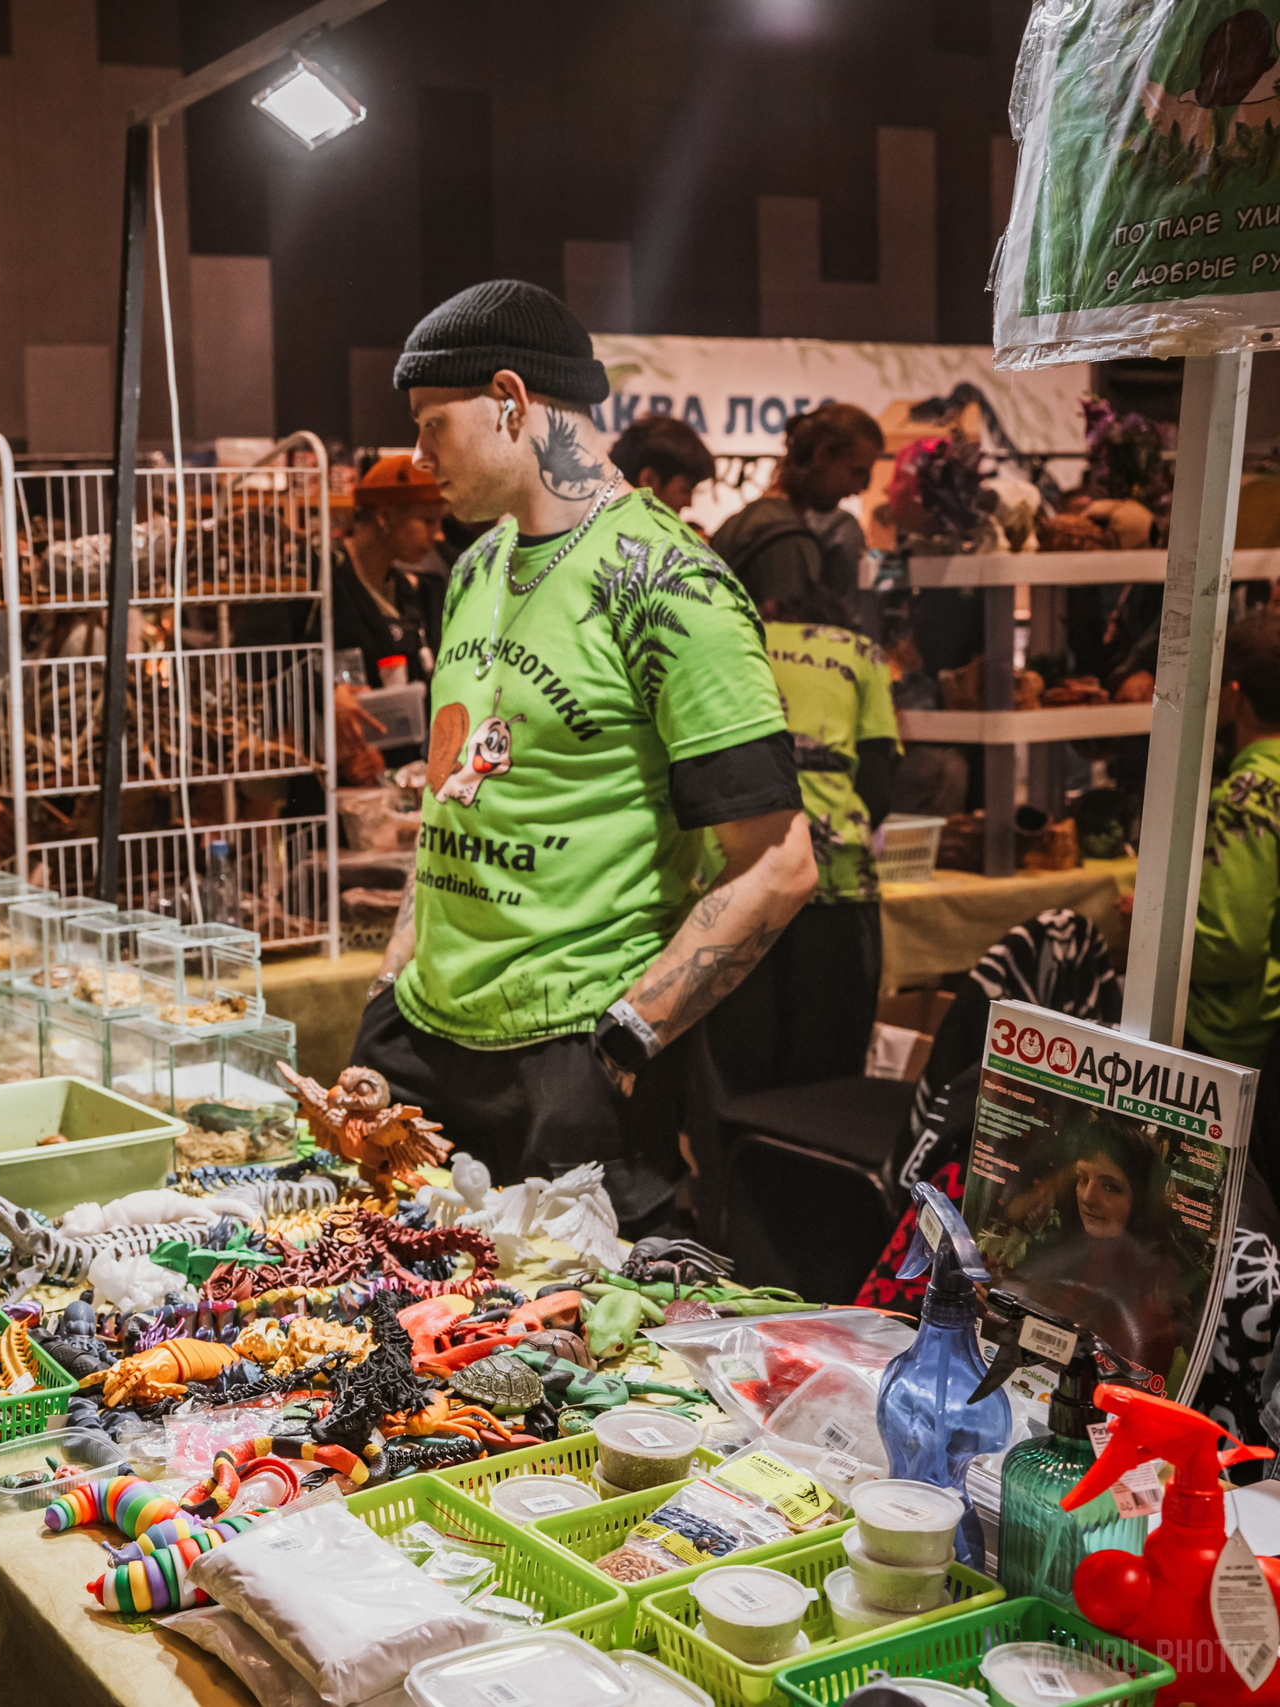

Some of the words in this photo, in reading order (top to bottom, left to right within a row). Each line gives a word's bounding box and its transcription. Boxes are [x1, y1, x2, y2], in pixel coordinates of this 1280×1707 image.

[1114, 223, 1145, 246] ПО
[1157, 212, 1221, 240] ПАРЕ
[1106, 270, 1119, 291] В
[1131, 256, 1237, 289] ДОБРЫЕ
[1122, 1099, 1200, 1132] МОСКВА
